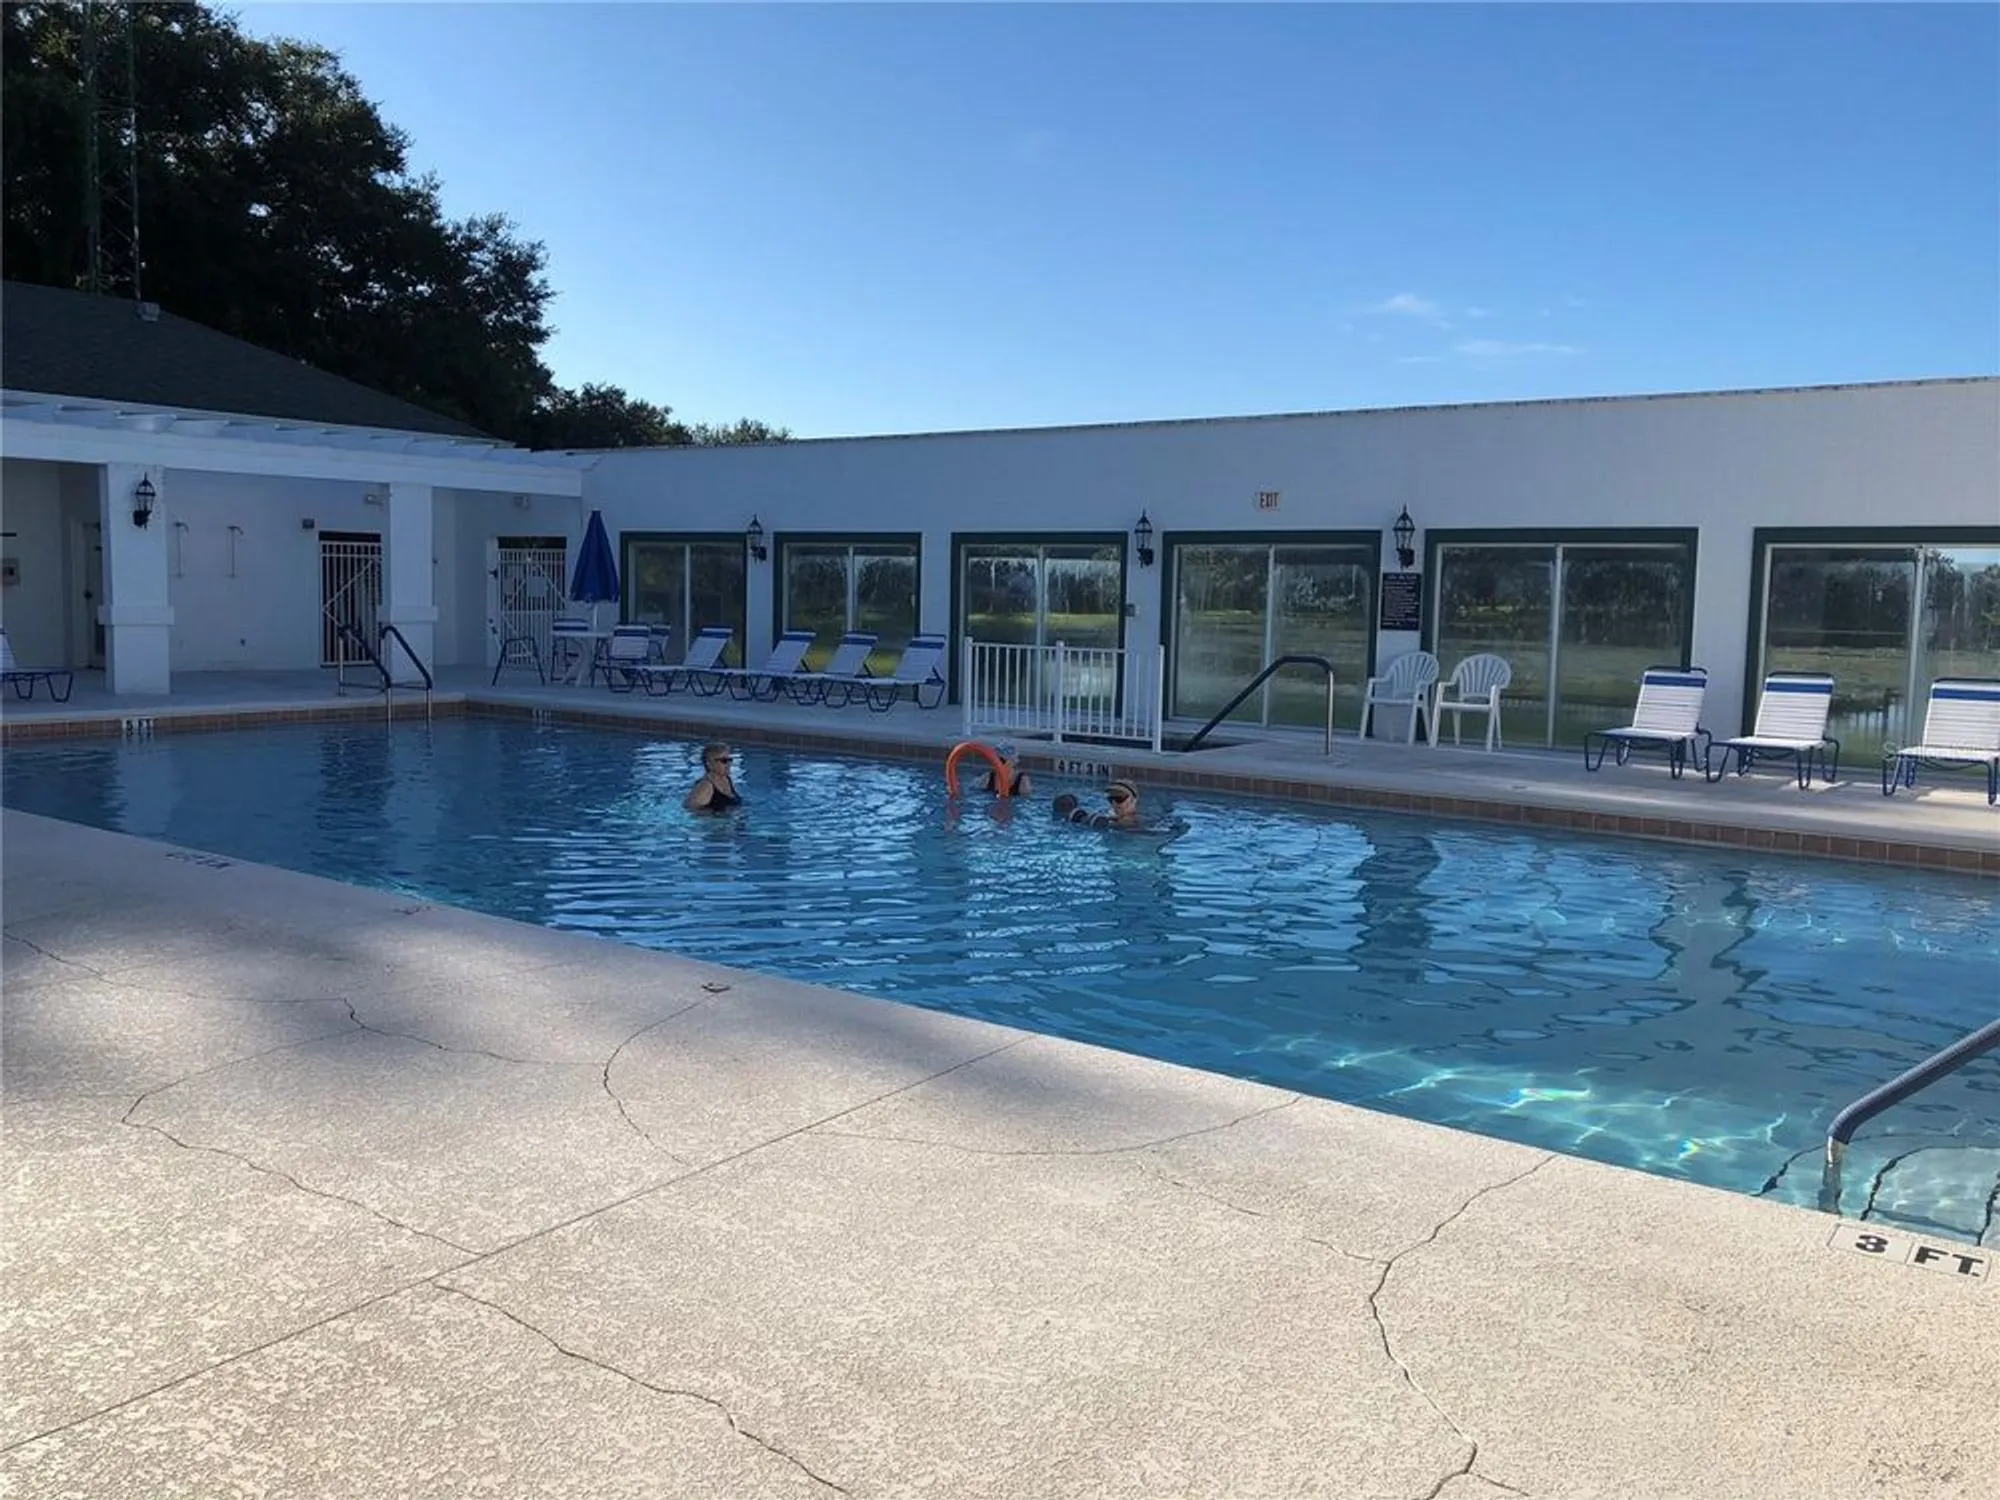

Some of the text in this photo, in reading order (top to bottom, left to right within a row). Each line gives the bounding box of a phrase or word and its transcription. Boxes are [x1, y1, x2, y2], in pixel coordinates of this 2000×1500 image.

[1259, 491, 1279, 509] EXIT
[1097, 763, 1110, 777] IN
[1855, 1234, 1985, 1278] 3 FT.
